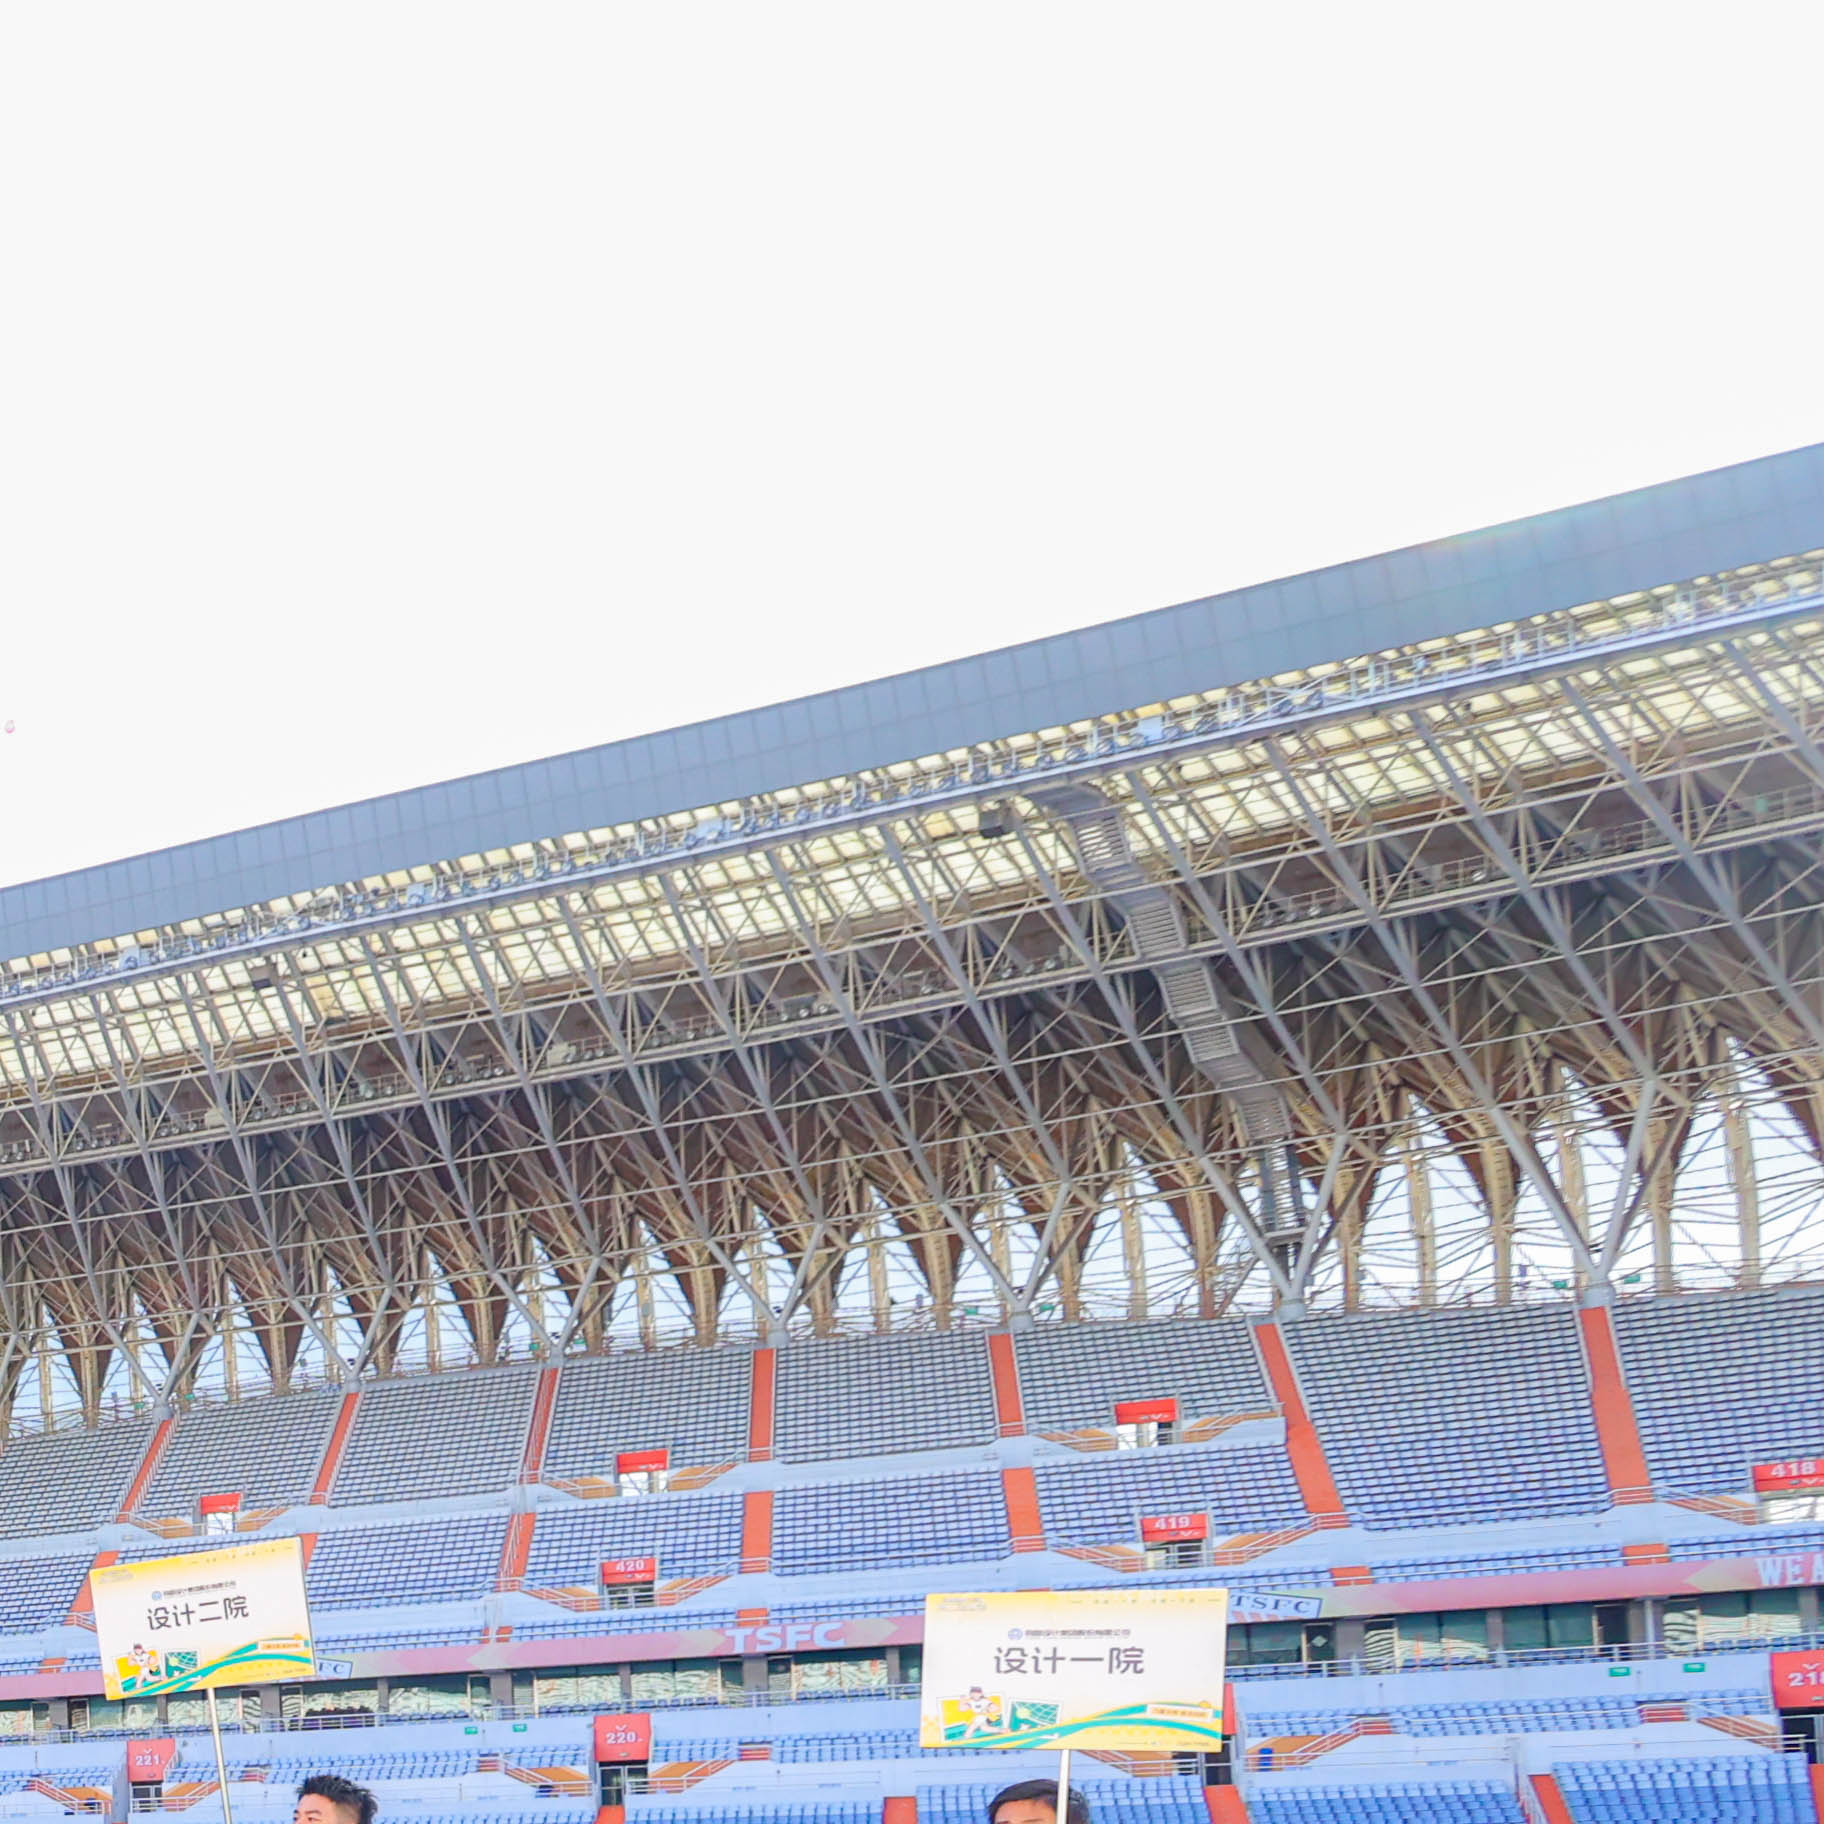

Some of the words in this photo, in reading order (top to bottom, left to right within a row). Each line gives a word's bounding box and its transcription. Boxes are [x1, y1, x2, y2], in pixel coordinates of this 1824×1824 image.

[1771, 1461, 1817, 1478] 418
[1154, 1515, 1191, 1530] 419
[616, 1559, 645, 1571] 420
[1756, 1556, 1804, 1587] WE
[147, 1595, 249, 1630] 设计二院
[1233, 1593, 1311, 1614] TSFC
[725, 1622, 845, 1654] TSFC
[994, 1646, 1144, 1674] 设计一院
[606, 1732, 637, 1744] 220
[135, 1755, 160, 1767] 221
